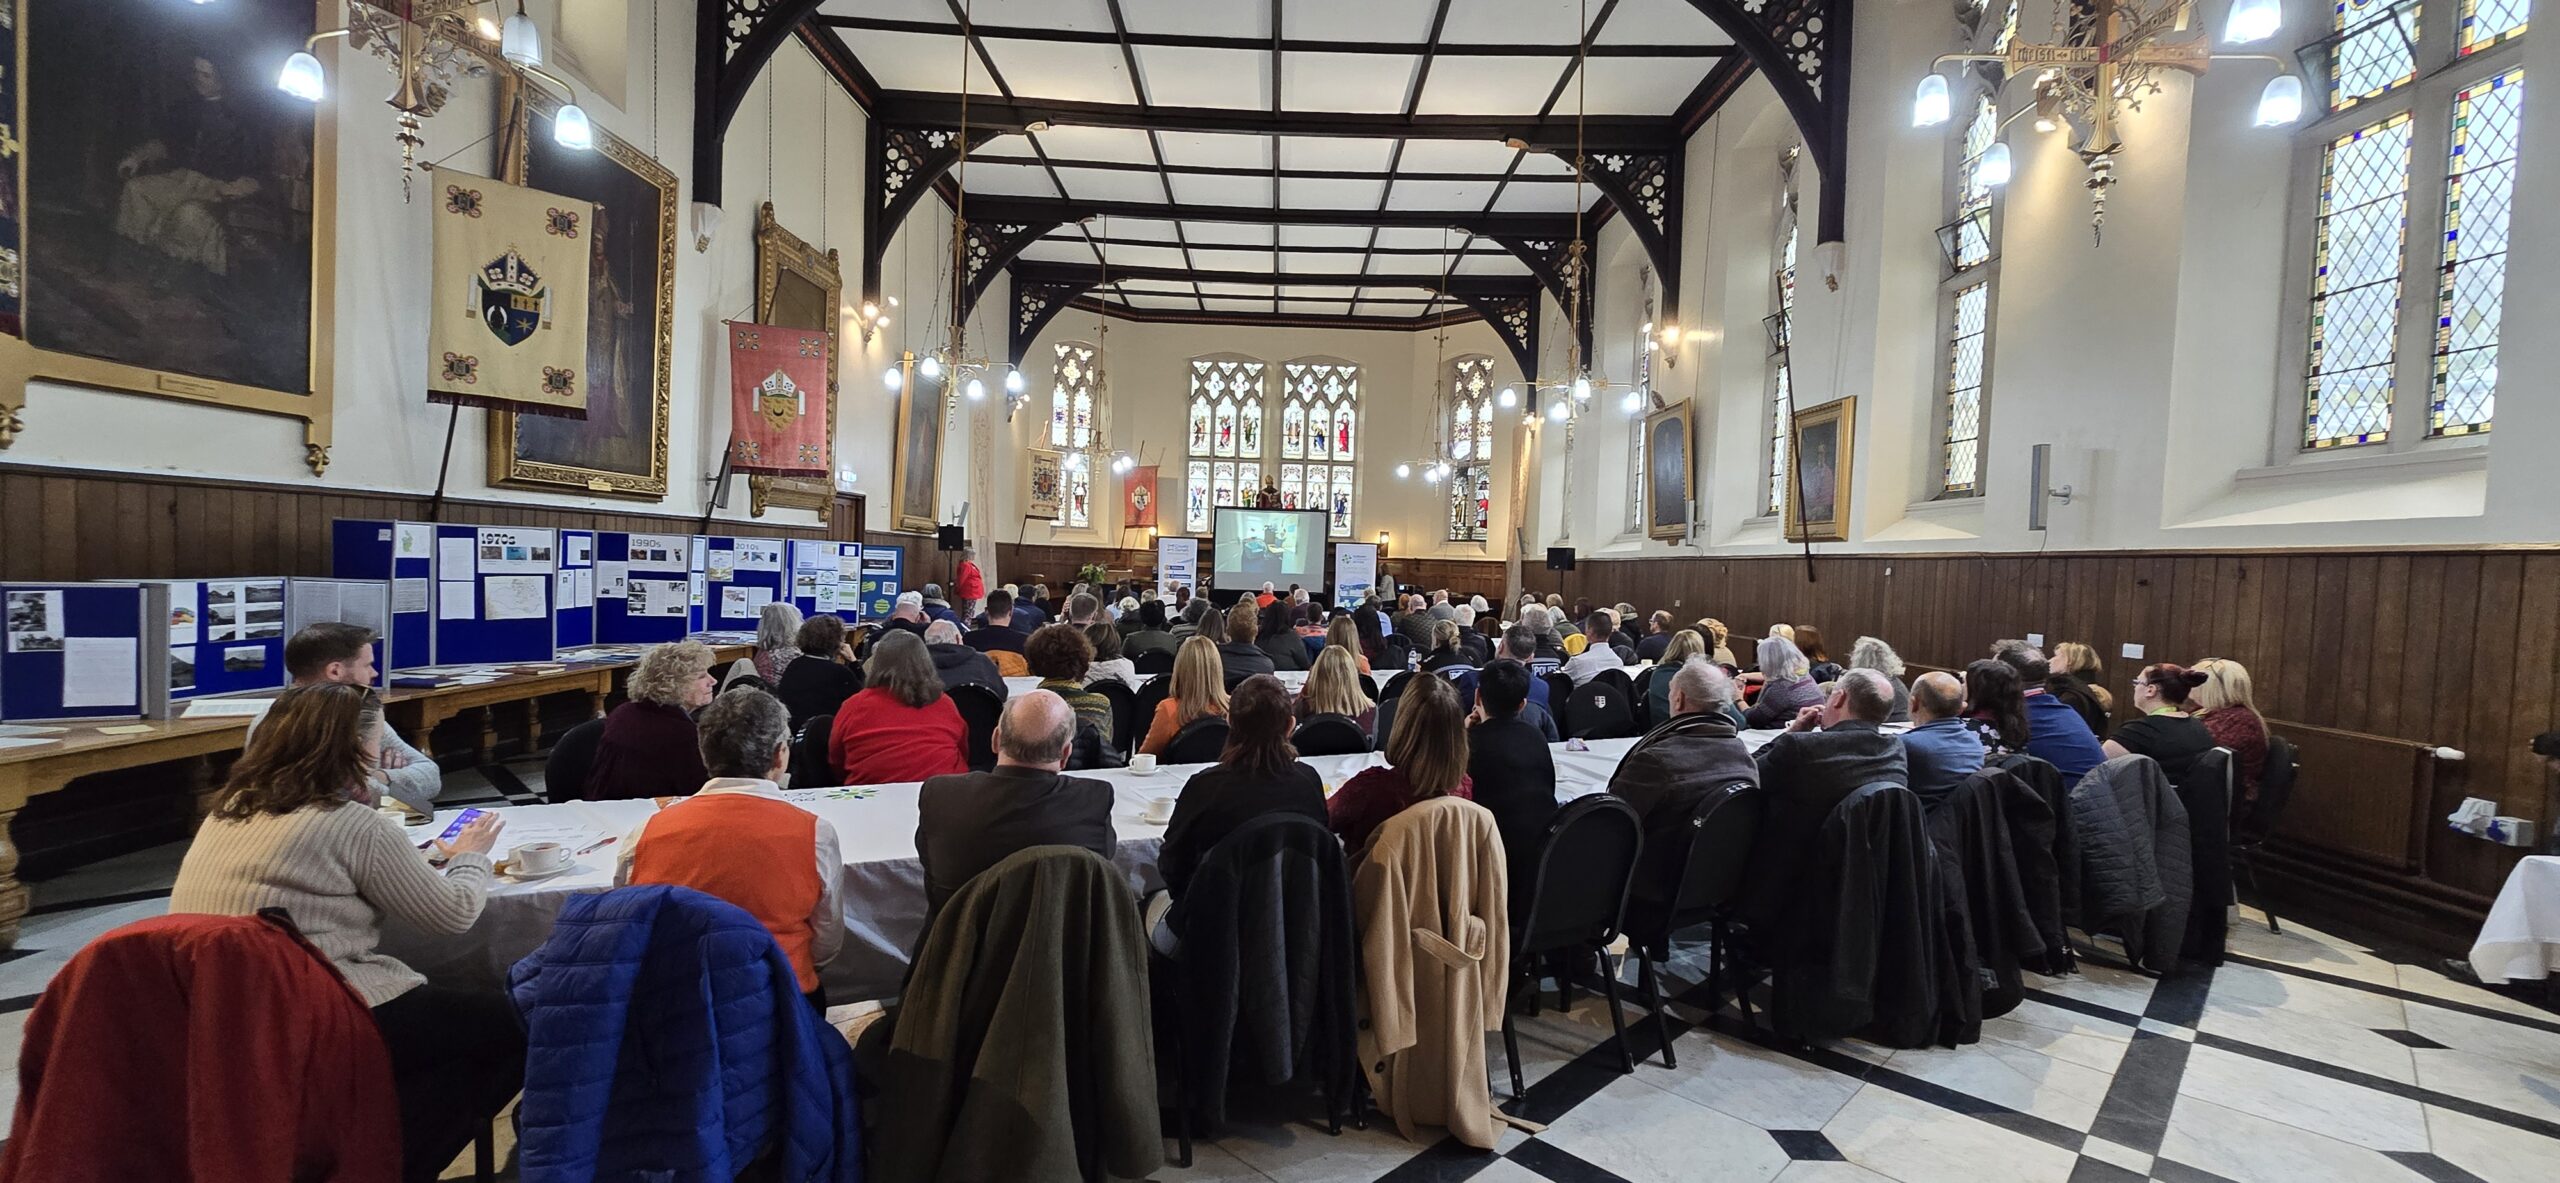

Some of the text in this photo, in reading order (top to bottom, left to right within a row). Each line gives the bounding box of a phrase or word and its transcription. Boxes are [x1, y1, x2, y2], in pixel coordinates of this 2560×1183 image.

[481, 533, 516, 545] 1970s
[631, 539, 661, 548] 1990s
[735, 542, 759, 551] 2010s
